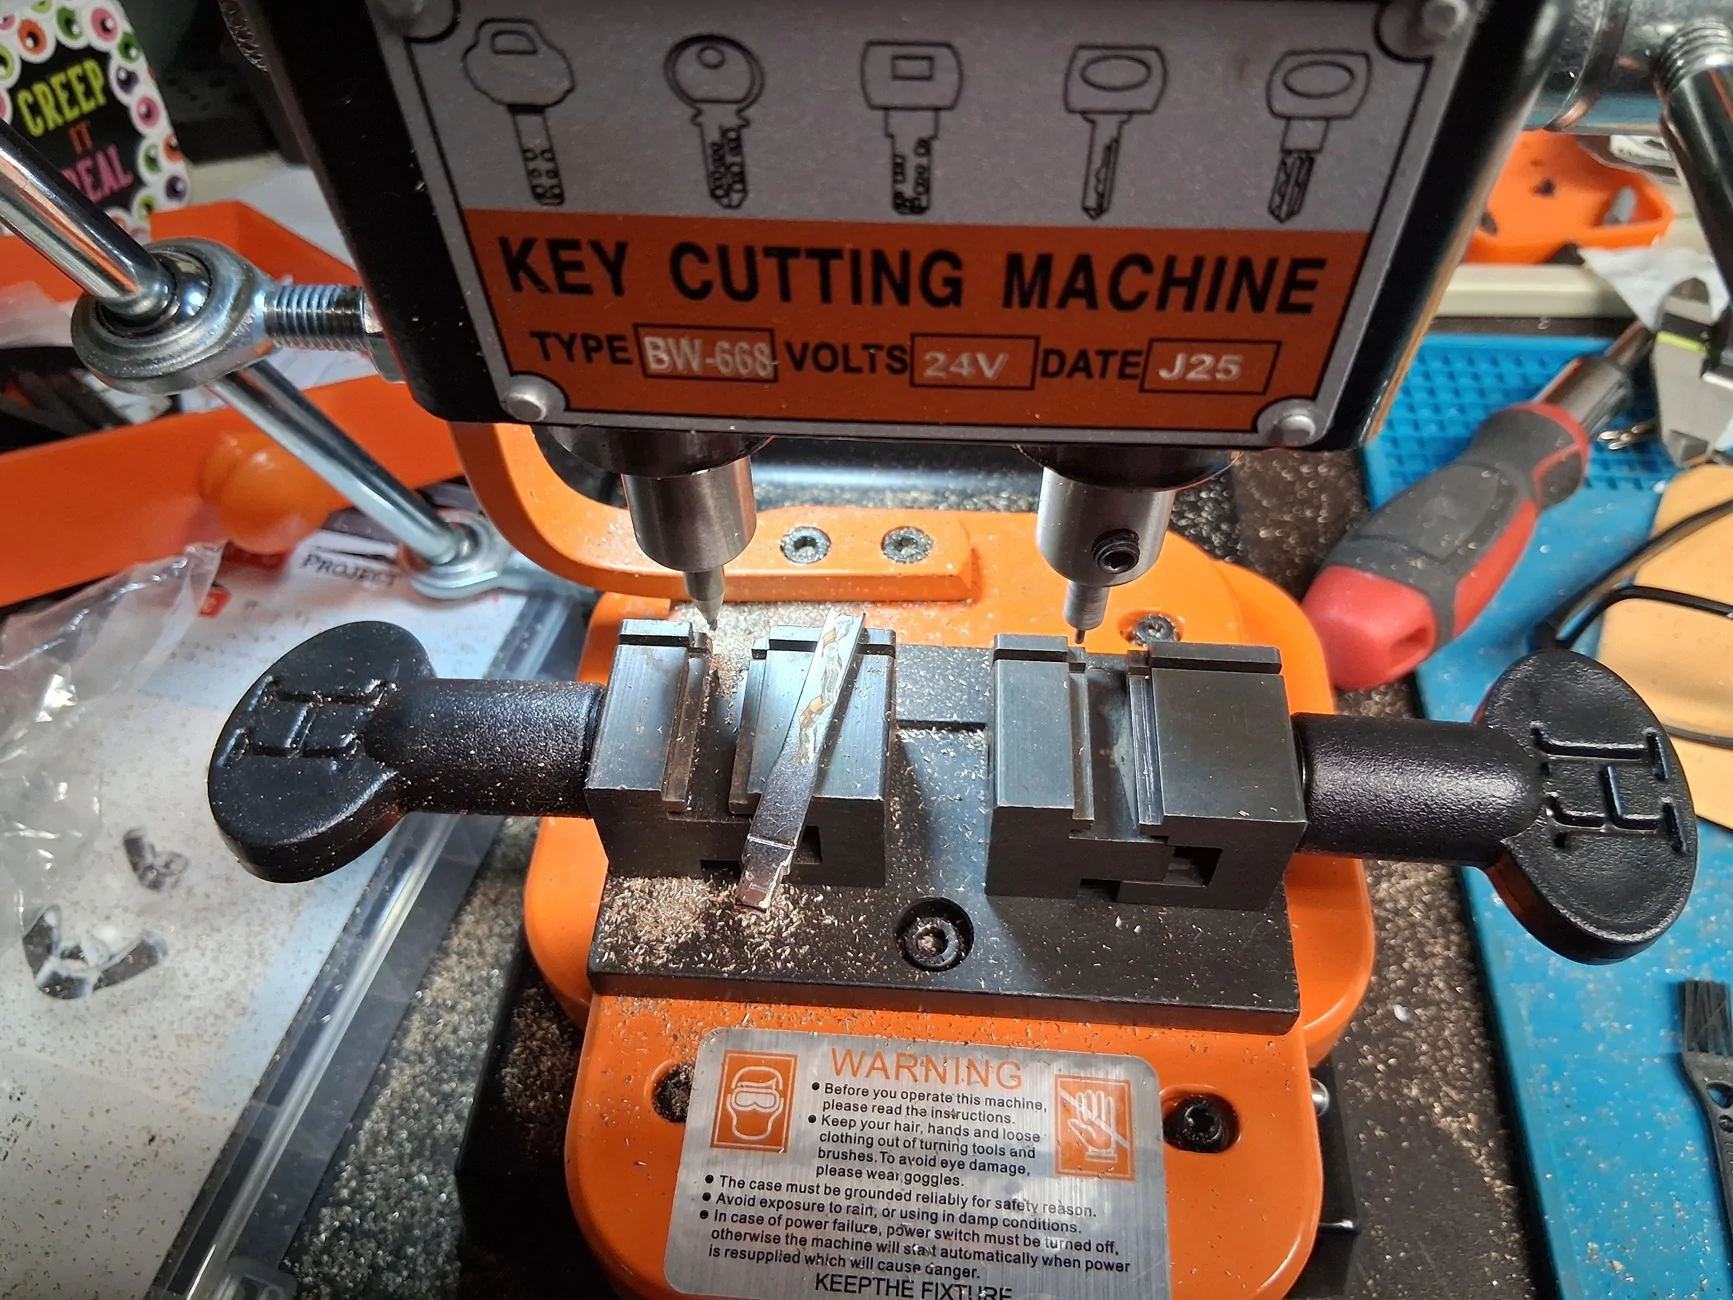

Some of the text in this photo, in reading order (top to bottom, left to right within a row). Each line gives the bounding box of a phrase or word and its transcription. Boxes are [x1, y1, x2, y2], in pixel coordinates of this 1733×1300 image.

[17, 58, 107, 137] CREEP
[68, 119, 93, 155] IT
[498, 237, 1327, 315] KEY CUTTING MACHINE
[529, 331, 1244, 382] TYPE BW-668 VOLTS 24V DATE J25
[299, 552, 399, 588] PROJECT
[832, 1048, 1023, 1090] WARNING
[823, 1099, 868, 1112] please
[872, 1104, 902, 1115] read
[906, 1105, 927, 1117] the
[824, 1082, 1047, 1112] Before you operate this machine,
[819, 1131, 1036, 1159] clothing out of turning tools and
[821, 1114, 1040, 1142] Keep your hair, hands and loose
[816, 1164, 964, 1187] please wear goggles.
[899, 1155, 937, 1168] avoid
[940, 1159, 965, 1171] eye
[969, 1159, 1030, 1176] damage,
[716, 1192, 1082, 1234] Avoid exposure to rain, or using in damp conditions.
[720, 1175, 1097, 1217] The case must be grounded reliably for safety reason.
[711, 1228, 781, 1244] otherwise
[785, 1233, 807, 1247] the
[811, 1236, 872, 1251] machine
[876, 1241, 900, 1254] will
[940, 1247, 1038, 1268] automatically
[1042, 1255, 1081, 1268] when
[1085, 1259, 1130, 1272] power
[714, 1209, 1119, 1256] In case of power failure, power switch must be turned off,
[708, 1244, 980, 1280] is resupplied which will cause danger.
